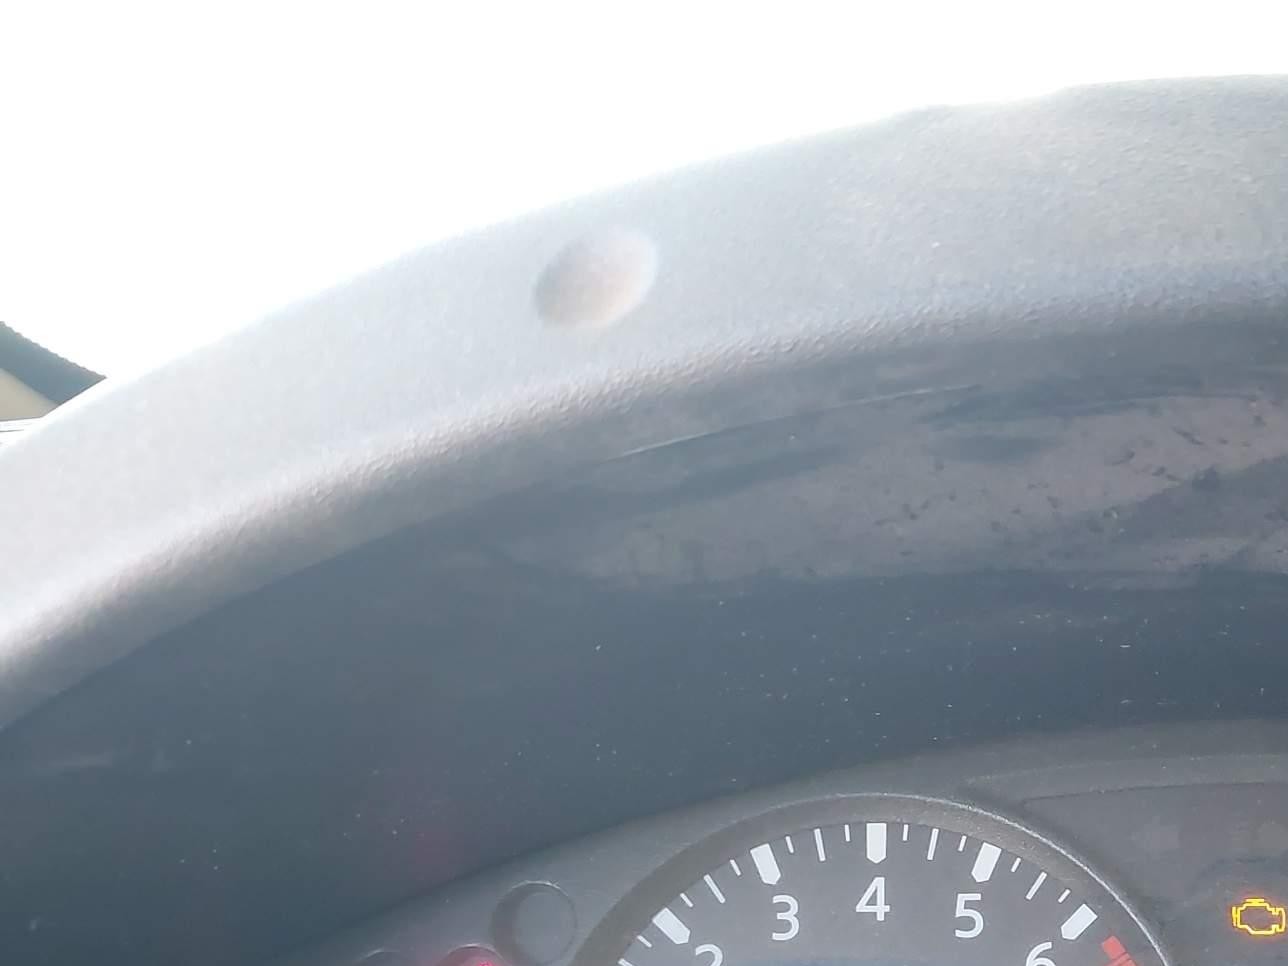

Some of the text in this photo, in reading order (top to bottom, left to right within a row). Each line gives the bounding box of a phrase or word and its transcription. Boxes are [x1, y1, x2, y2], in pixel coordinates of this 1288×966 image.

[772, 895, 799, 941] 3
[856, 877, 890, 921] 4
[955, 893, 984, 938] 5
